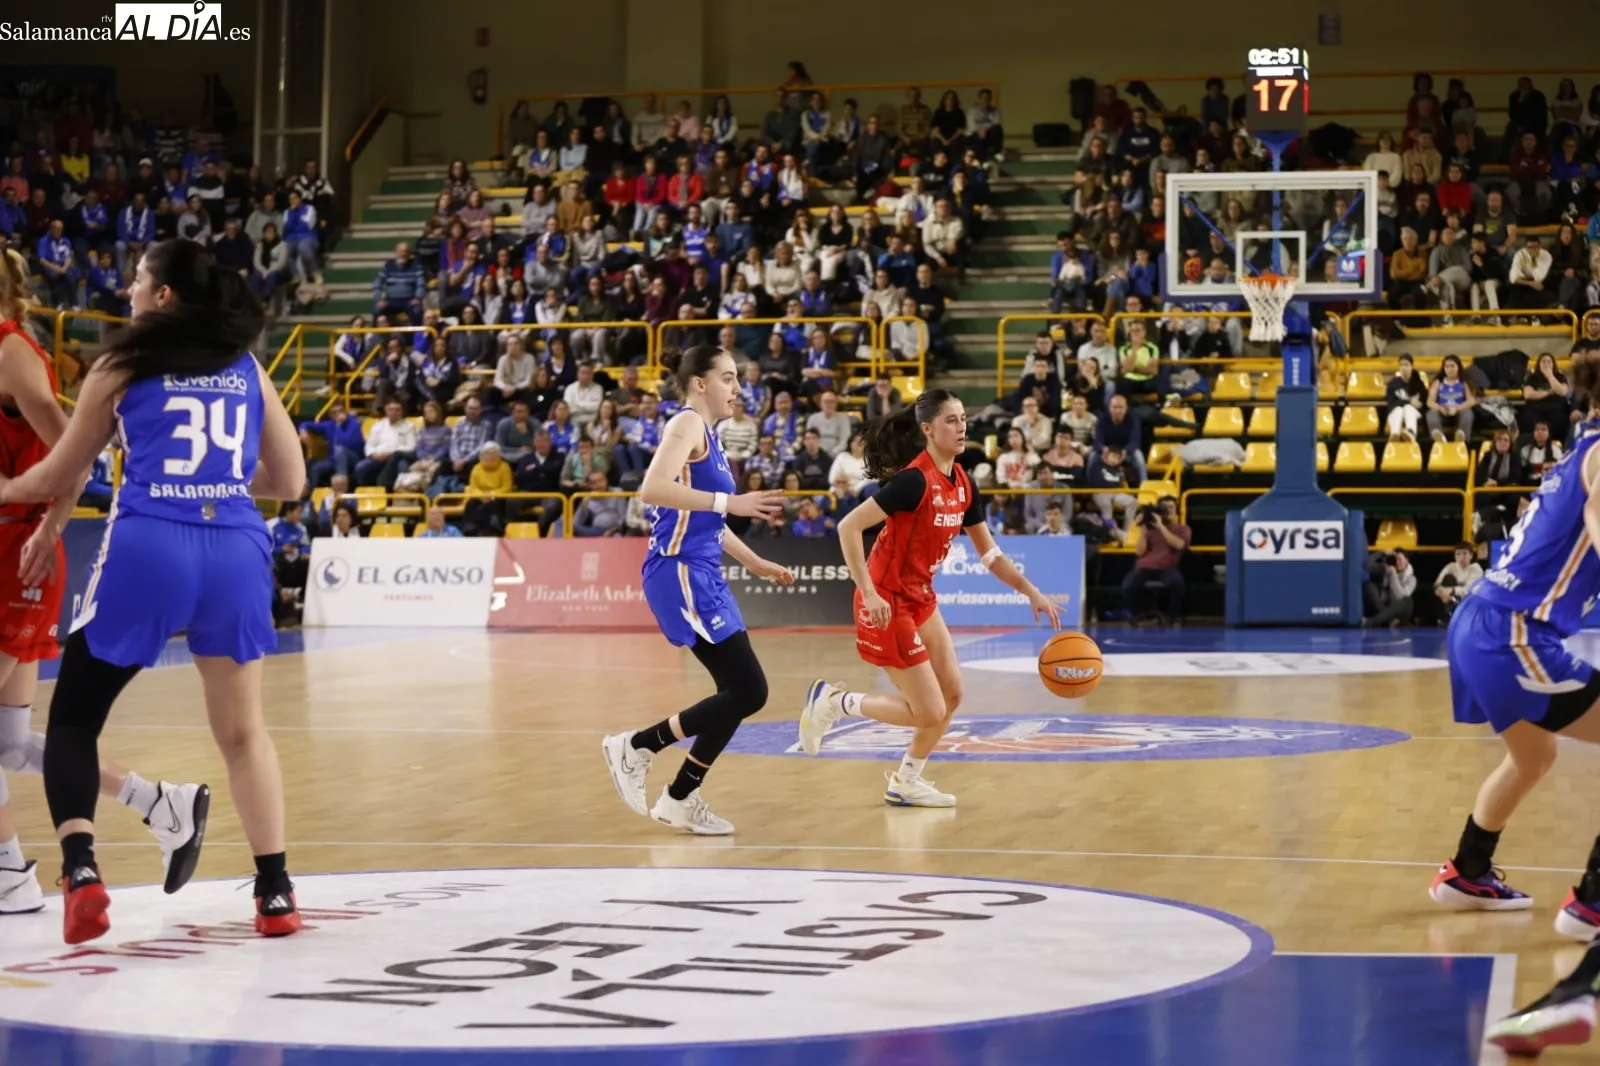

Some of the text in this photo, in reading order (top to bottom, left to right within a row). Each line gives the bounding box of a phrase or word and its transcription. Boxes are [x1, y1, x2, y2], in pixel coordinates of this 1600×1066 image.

[1248, 47, 1299, 65] 02:51
[1252, 79, 1298, 112] 17
[163, 397, 247, 480] 34
[357, 564, 484, 585] EL GANSO
[526, 584, 600, 602] Elizabeth
[455, 889, 1048, 1028] CASTILLA
